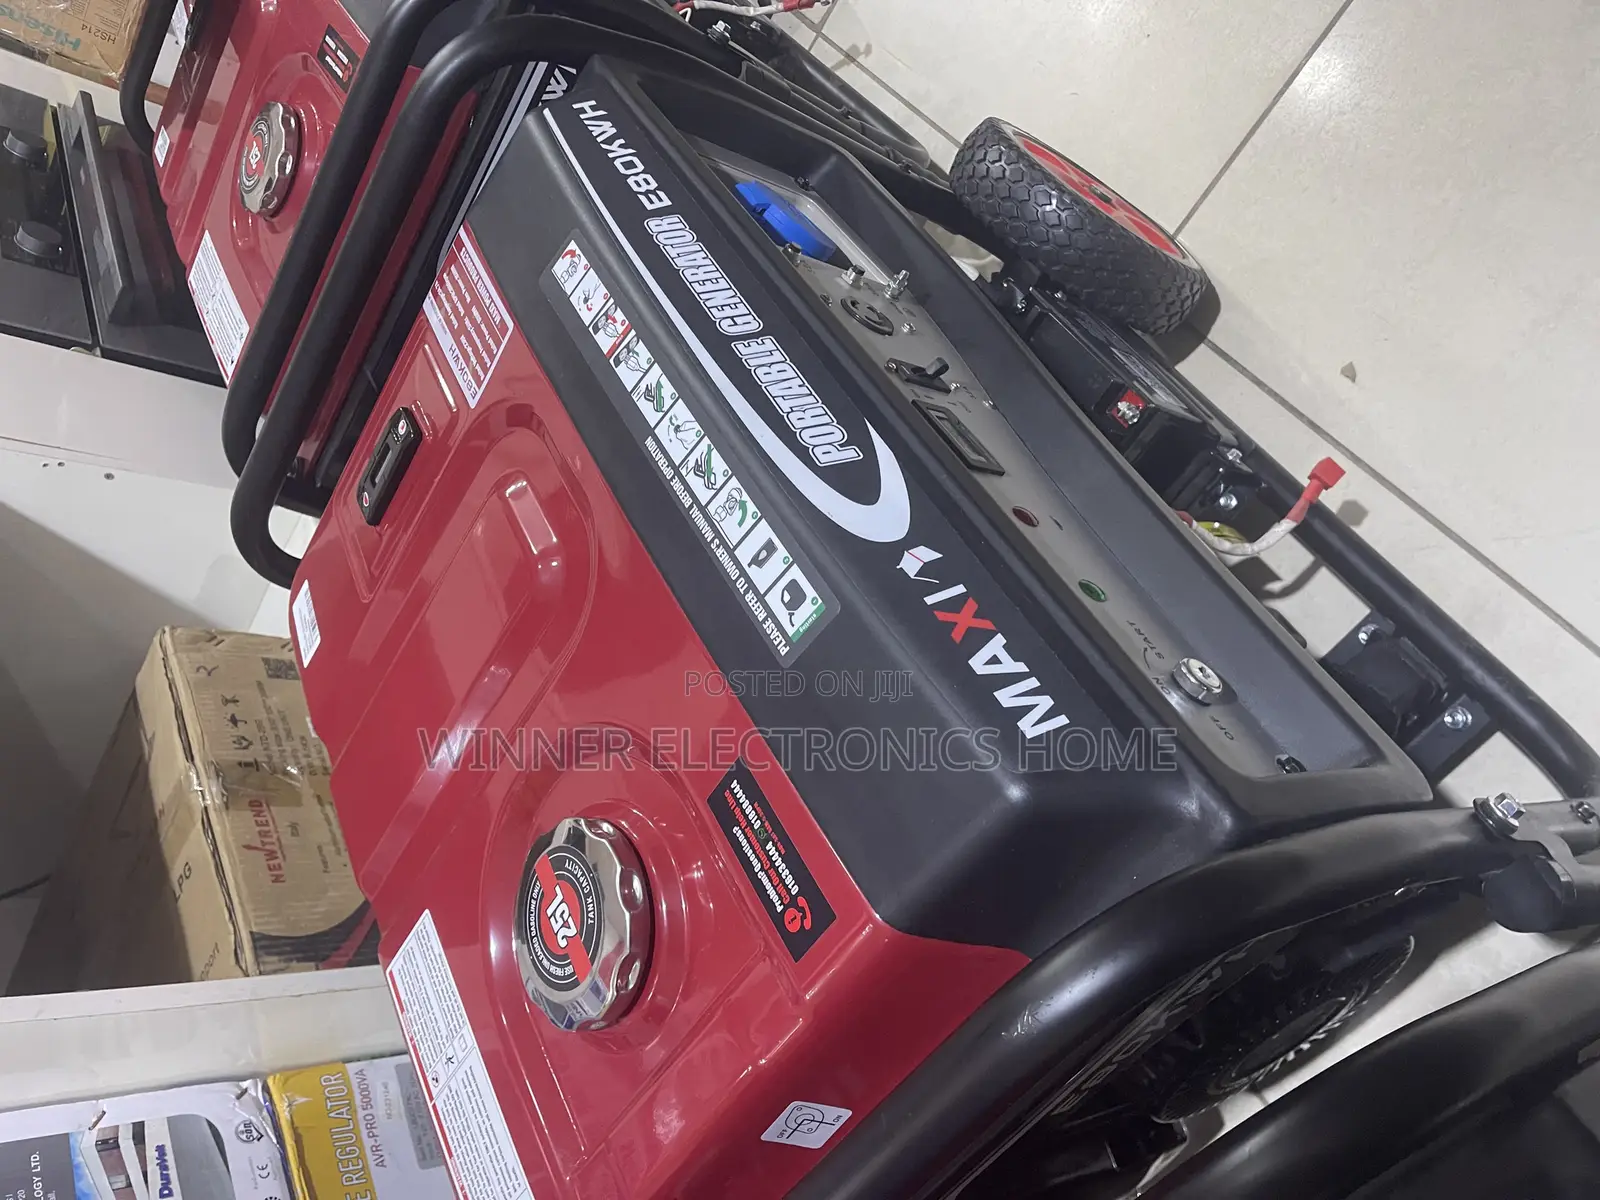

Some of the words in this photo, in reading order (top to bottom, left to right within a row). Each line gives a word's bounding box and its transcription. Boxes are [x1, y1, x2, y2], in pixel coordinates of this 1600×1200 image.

[81, 23, 117, 45] HS214
[571, 100, 673, 211] E80KWH
[476, 279, 492, 306] POWER
[644, 214, 763, 336] GENERATOR
[448, 343, 478, 401] E80KWH
[731, 336, 863, 467] PORTABLE
[645, 437, 675, 479] OPERATION
[670, 477, 693, 507] BEFORE
[689, 504, 715, 541] MANUAL
[711, 539, 740, 580] OWNER'S
[736, 578, 749, 593] TO
[745, 591, 767, 620] REFER
[763, 619, 789, 655] PLEASE
[1127, 621, 1164, 660] START
[923, 583, 1070, 740] MAXI
[1152, 677, 1171, 695] ON
[1209, 716, 1235, 741] OFF
[724, 790, 736, 809] Line
[733, 807, 747, 829] Help
[242, 798, 287, 885] NEWTREND
[733, 824, 761, 873] Questions?
[745, 826, 770, 870] Customer
[173, 861, 193, 903] LPG
[564, 858, 590, 894] CAPACITY
[766, 841, 799, 896] 016334444
[768, 868, 779, 886] Our
[532, 879, 542, 900] ONLY
[758, 870, 783, 912] Problem?
[777, 884, 790, 904] Call
[529, 899, 538, 937] GASOLINE
[546, 884, 578, 948] 25L
[585, 896, 596, 926] TANK
[531, 936, 551, 971] UNLEADED
[564, 963, 575, 977] USE
[354, 1068, 375, 1111] 5000VA
[320, 1072, 368, 1187] REGULATOR
[363, 1114, 388, 1169] AVR-PRO
[30, 1151, 41, 1173] LTD.
[154, 1143, 175, 1199] DuraVolt
